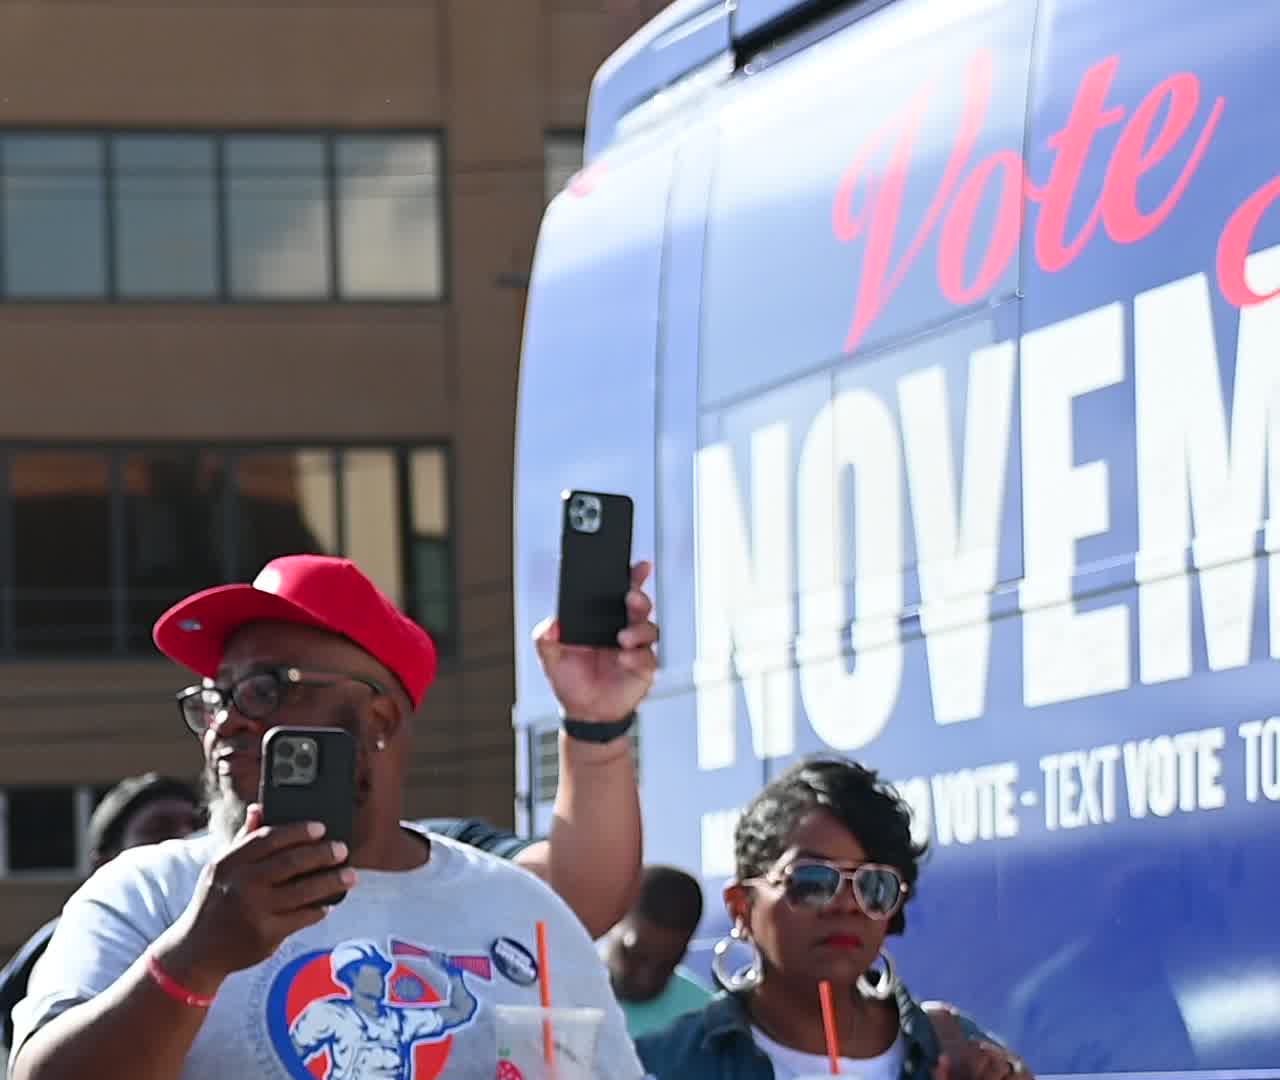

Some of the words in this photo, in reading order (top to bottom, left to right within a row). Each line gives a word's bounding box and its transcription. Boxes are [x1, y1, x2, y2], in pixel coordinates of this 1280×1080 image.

[832, 49, 1226, 352] Vote
[930, 760, 1020, 846] VOTE
[1040, 747, 1121, 832] TEXT
[1123, 727, 1226, 819] VOTE
